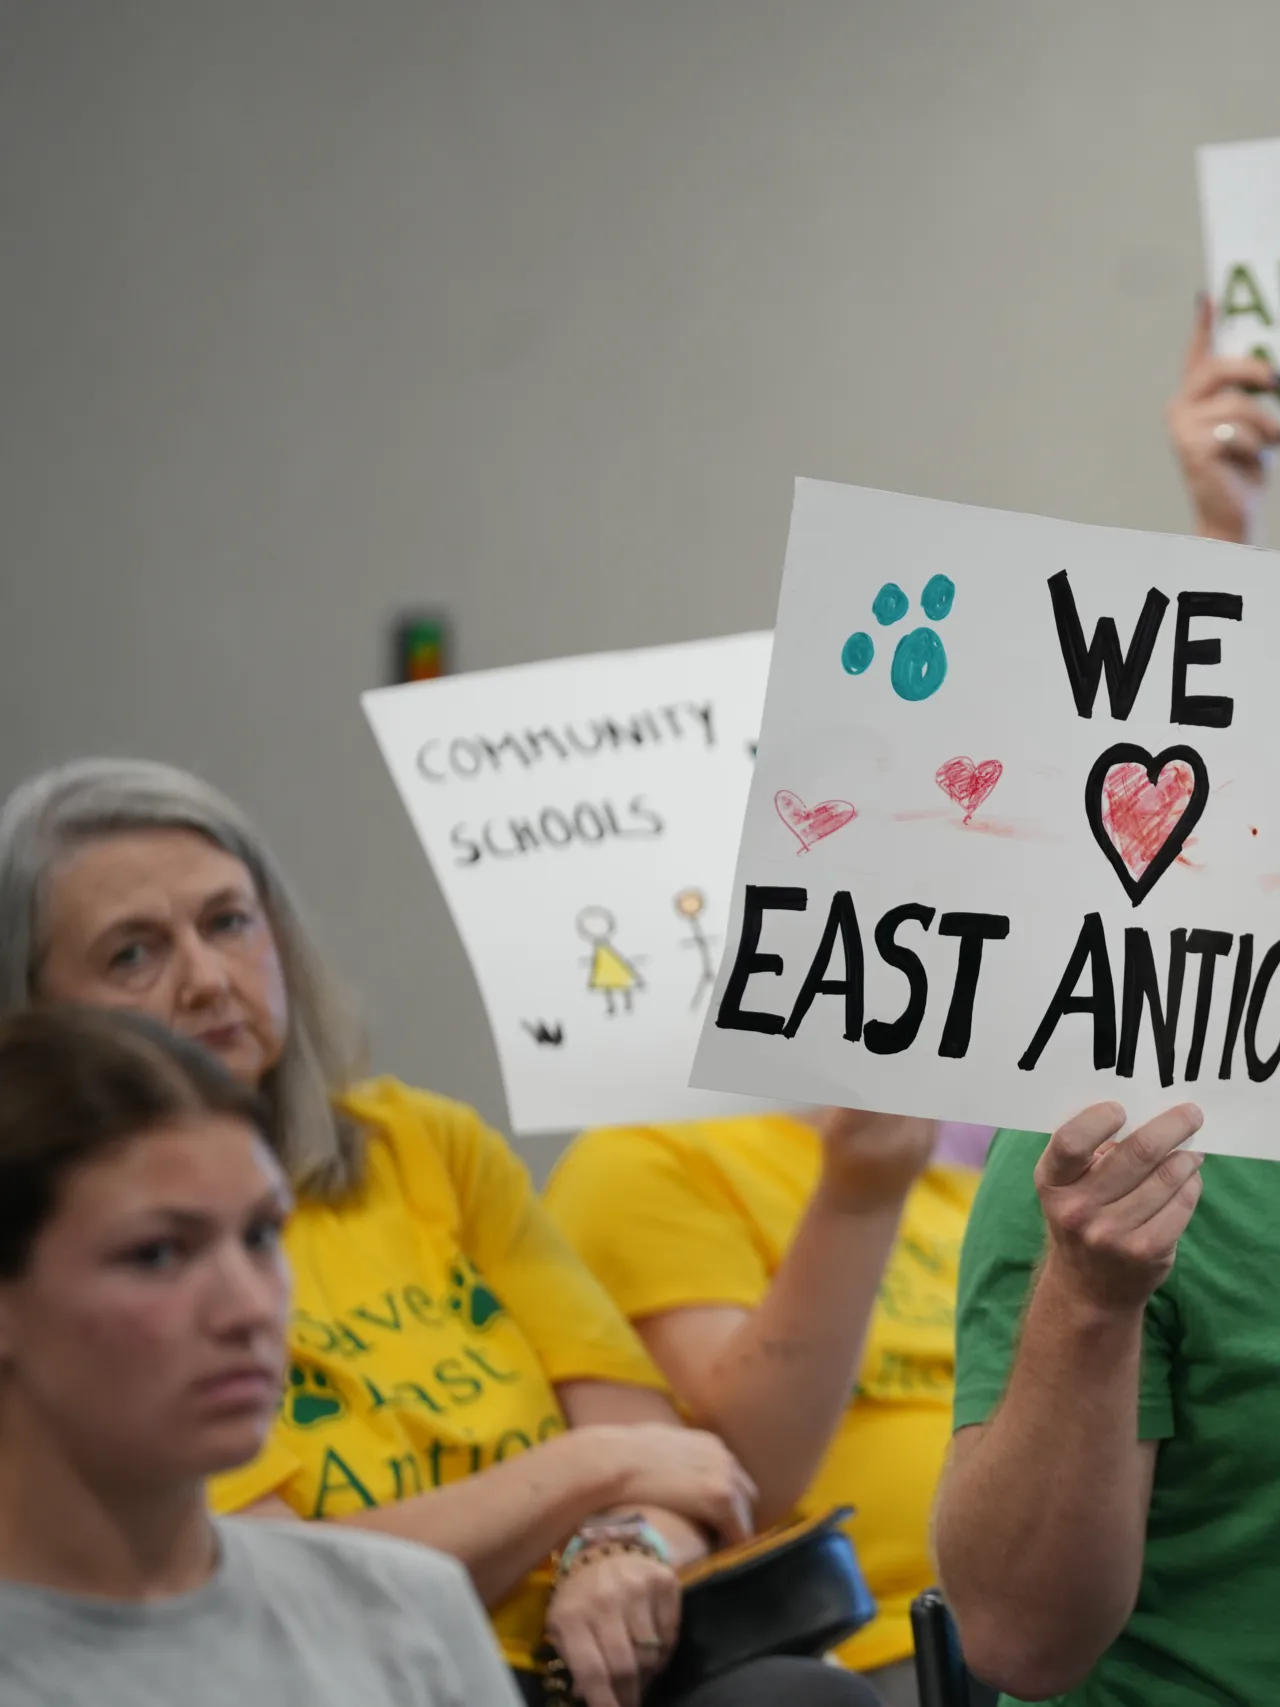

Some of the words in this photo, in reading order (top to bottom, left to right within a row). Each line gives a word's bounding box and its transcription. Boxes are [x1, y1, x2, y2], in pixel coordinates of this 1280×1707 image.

[1046, 568, 1243, 728] WE
[416, 700, 715, 783] COMMUNITY
[450, 795, 665, 867] SCHOOLS
[715, 884, 1010, 1060] EAST
